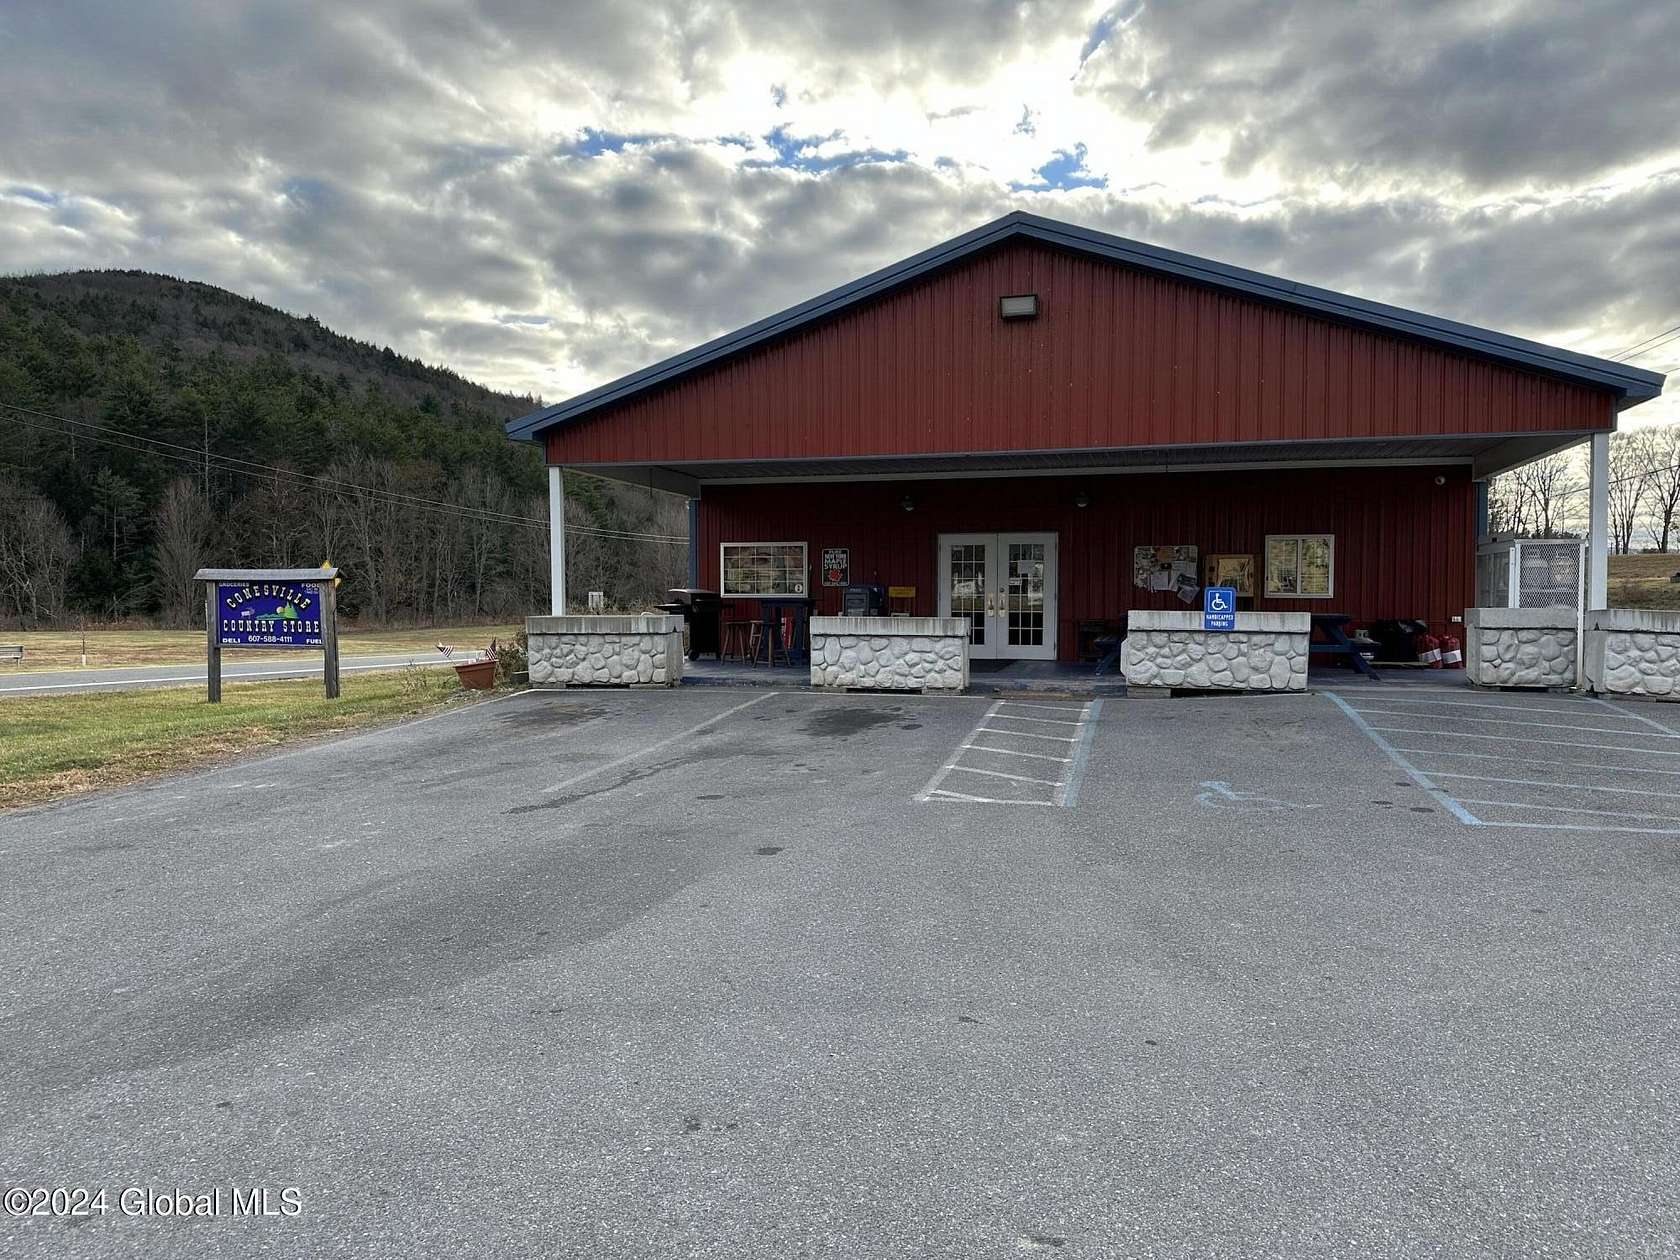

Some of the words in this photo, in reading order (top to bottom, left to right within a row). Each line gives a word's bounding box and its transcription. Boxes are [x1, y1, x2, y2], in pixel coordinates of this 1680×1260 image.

[226, 585, 311, 609] CONESVILLE
[223, 620, 275, 632] COUNTRY
[282, 620, 320, 632] STORE
[248, 635, 293, 643] 607-588-4111
